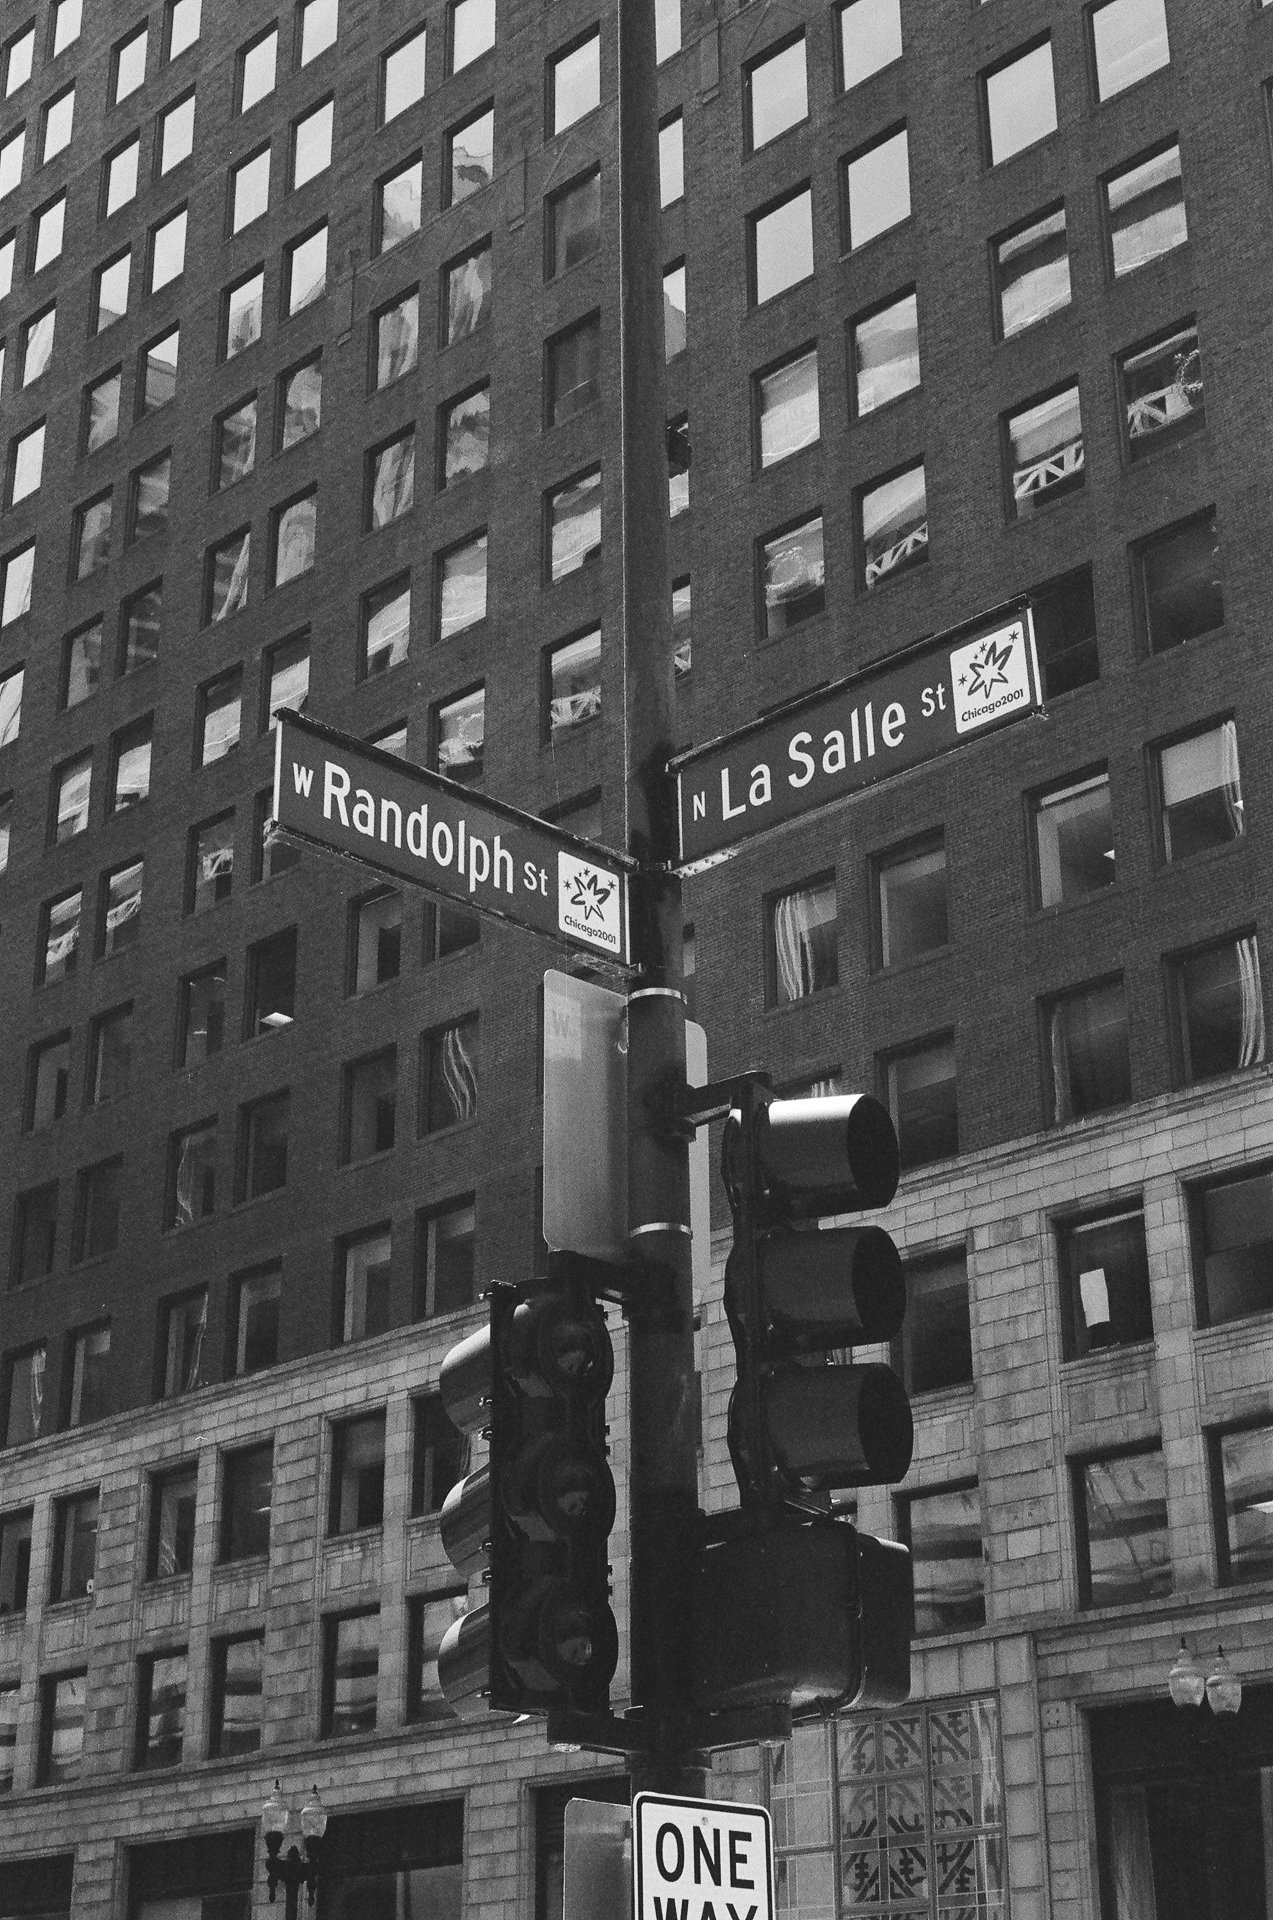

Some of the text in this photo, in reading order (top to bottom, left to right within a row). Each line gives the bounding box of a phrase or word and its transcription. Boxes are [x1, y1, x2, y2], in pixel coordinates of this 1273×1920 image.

[961, 688, 1024, 722] Chicago2001
[693, 682, 947, 822] N La Salle St
[292, 760, 549, 897] W Randolph St
[564, 915, 617, 945] Chicago2001
[655, 1822, 755, 1890] ONE
